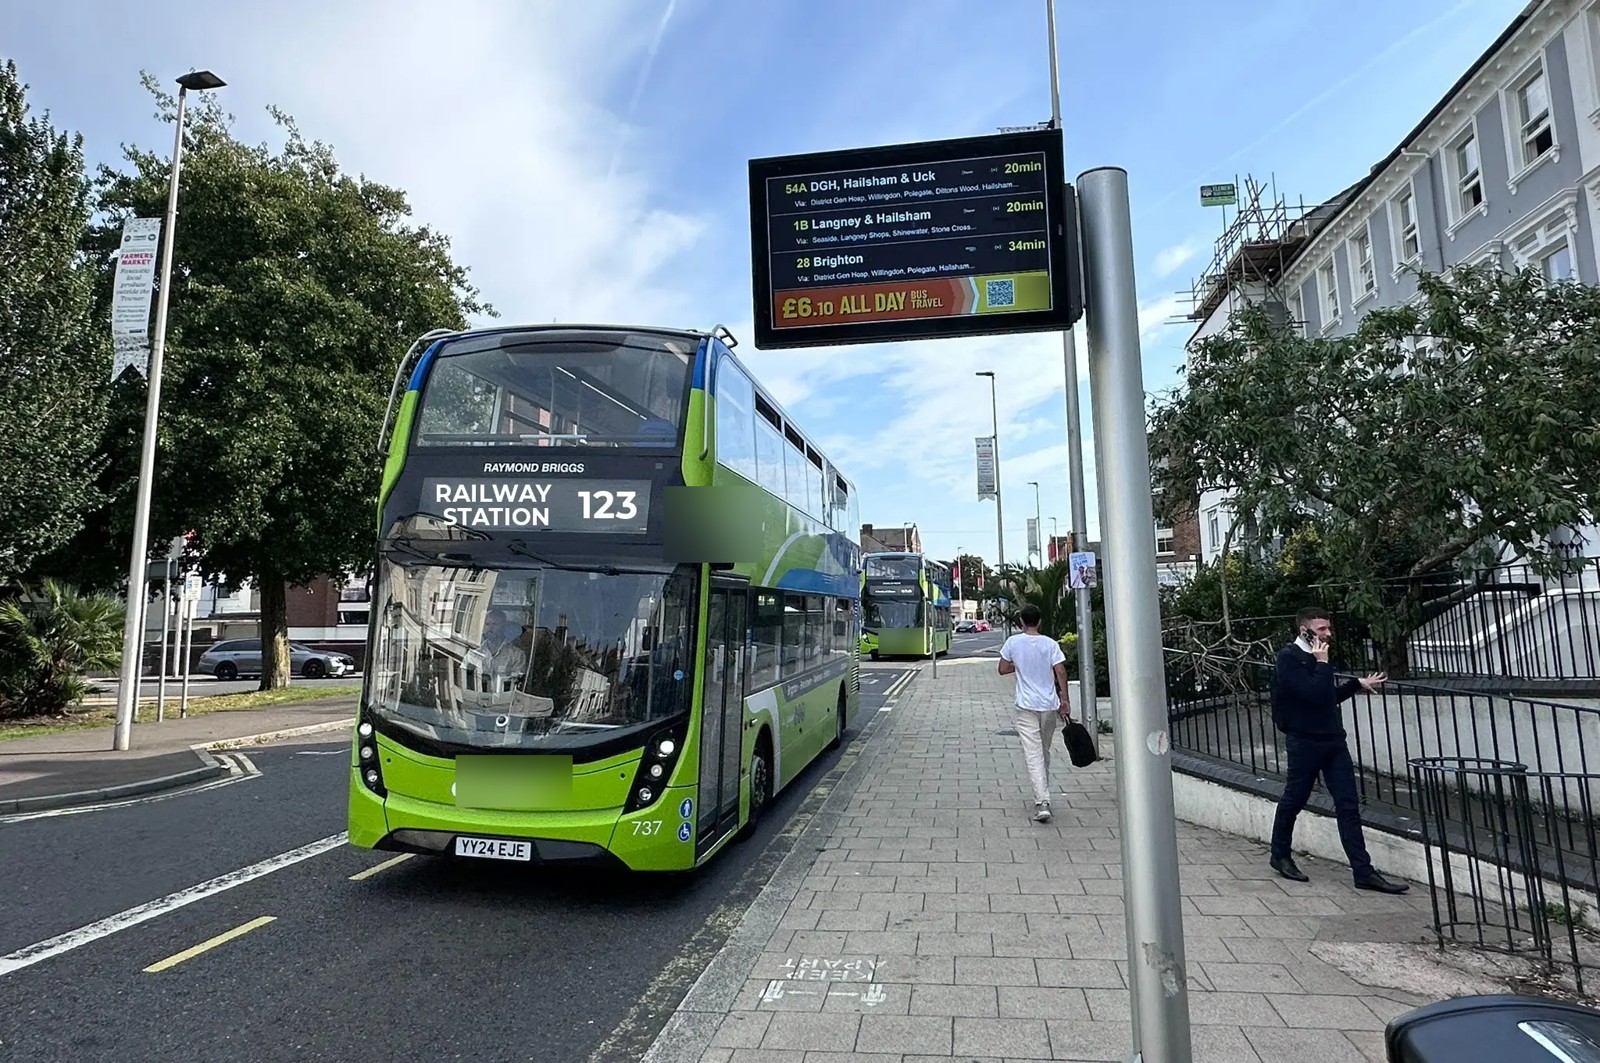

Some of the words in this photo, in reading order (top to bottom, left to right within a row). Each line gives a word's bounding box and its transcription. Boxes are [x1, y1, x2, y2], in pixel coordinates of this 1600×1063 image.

[1004, 161, 1042, 174] 20min
[785, 183, 807, 194] 54A
[810, 180, 840, 192] DGH,
[843, 176, 897, 189] Hailsham
[900, 173, 910, 183] &
[912, 171, 936, 182] Uck
[810, 197, 833, 206] District
[833, 196, 847, 204] Gen
[848, 195, 867, 204] Hosp,
[868, 191, 903, 201] Willingdon,
[903, 189, 934, 199] Polegate,
[935, 187, 959, 195] Dittons
[959, 184, 981, 193] Wood,
[1006, 200, 1044, 213] 20min
[793, 220, 809, 231] 1B
[811, 216, 861, 231] Langney
[864, 214, 874, 225] &
[876, 210, 931, 224] Hailsham
[796, 237, 809, 245] Via:
[812, 235, 840, 244] Seaside,
[840, 233, 868, 243] Langney
[868, 230, 891, 240] Shops,
[892, 227, 930, 237] Shinewater,
[931, 226, 950, 234] Stone
[1008, 239, 1046, 252] 34min
[796, 257, 811, 268] 28
[813, 254, 864, 268] Brighton
[813, 273, 836, 281] District
[836, 272, 851, 280] Gen
[851, 270, 870, 279] Hosp,
[871, 268, 906, 277] Willingdon,
[907, 266, 937, 275] Polegate,
[910, 289, 928, 300] BUS
[782, 297, 834, 319] £6.10
[839, 294, 871, 315] ALL
[875, 291, 906, 313] DAY
[911, 297, 944, 309] TRAVEL
[483, 462, 540, 473] RAYMOND
[541, 462, 585, 473] BRIGGS
[435, 484, 552, 503] RAILWAY
[577, 491, 638, 520] 123
[443, 507, 550, 526] STATION
[631, 821, 663, 836] 737
[461, 839, 496, 857] YY24
[499, 842, 525, 859] EJE
[778, 958, 887, 969] APART
[786, 970, 874, 981] KEEP
